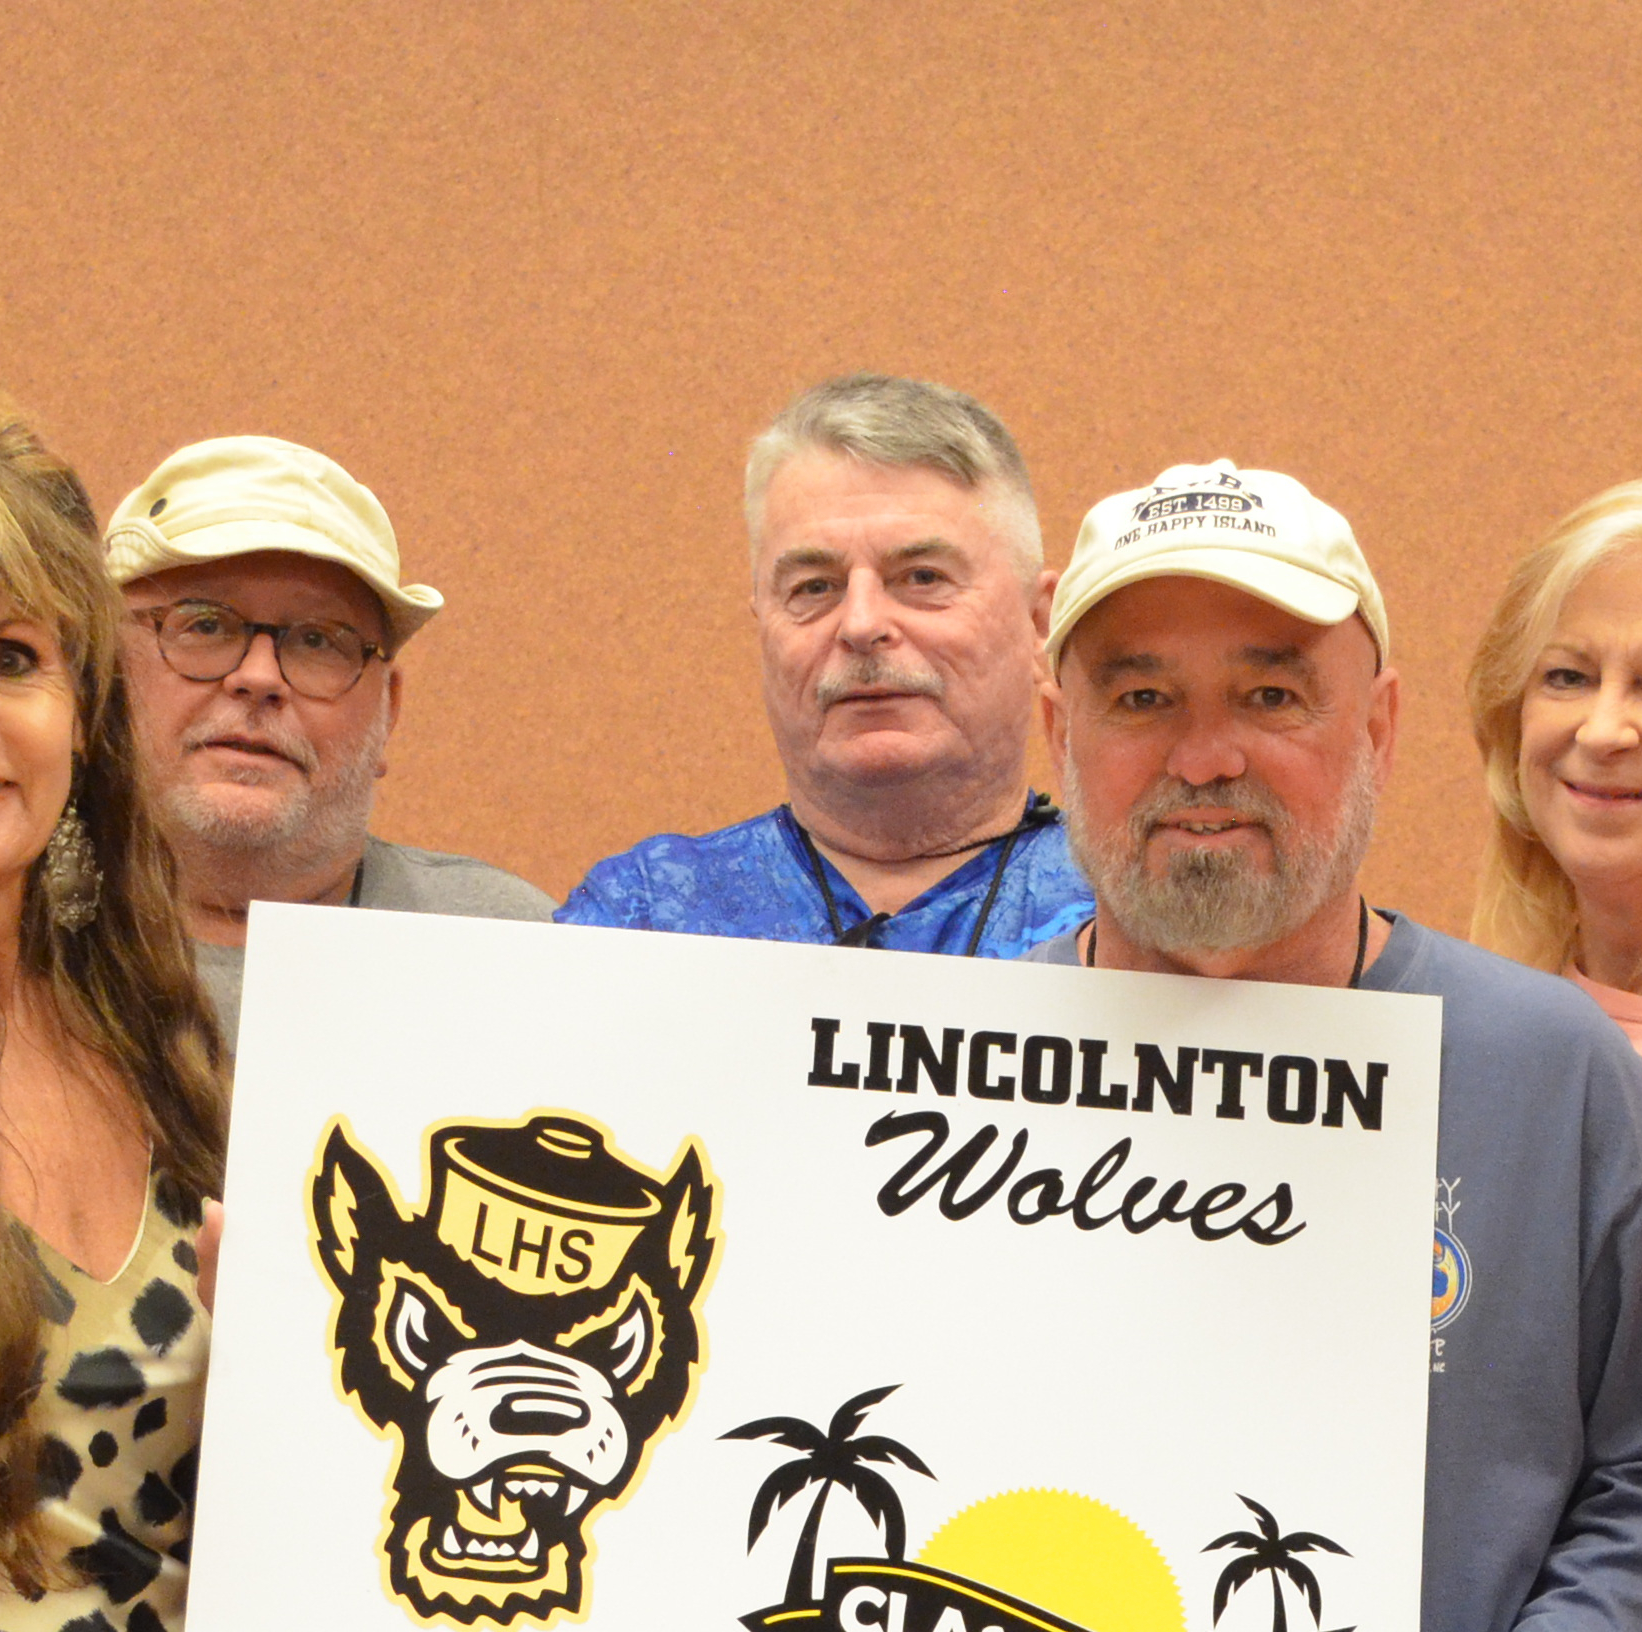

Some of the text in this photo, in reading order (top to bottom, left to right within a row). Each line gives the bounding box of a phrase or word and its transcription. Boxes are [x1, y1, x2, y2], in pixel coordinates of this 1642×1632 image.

[1113, 514, 1277, 551] ONE HAPPY ISLAND
[806, 1016, 1389, 1132] LINCOLNTON
[864, 1109, 1308, 1246] Wolves
[471, 1201, 596, 1285] LHS
